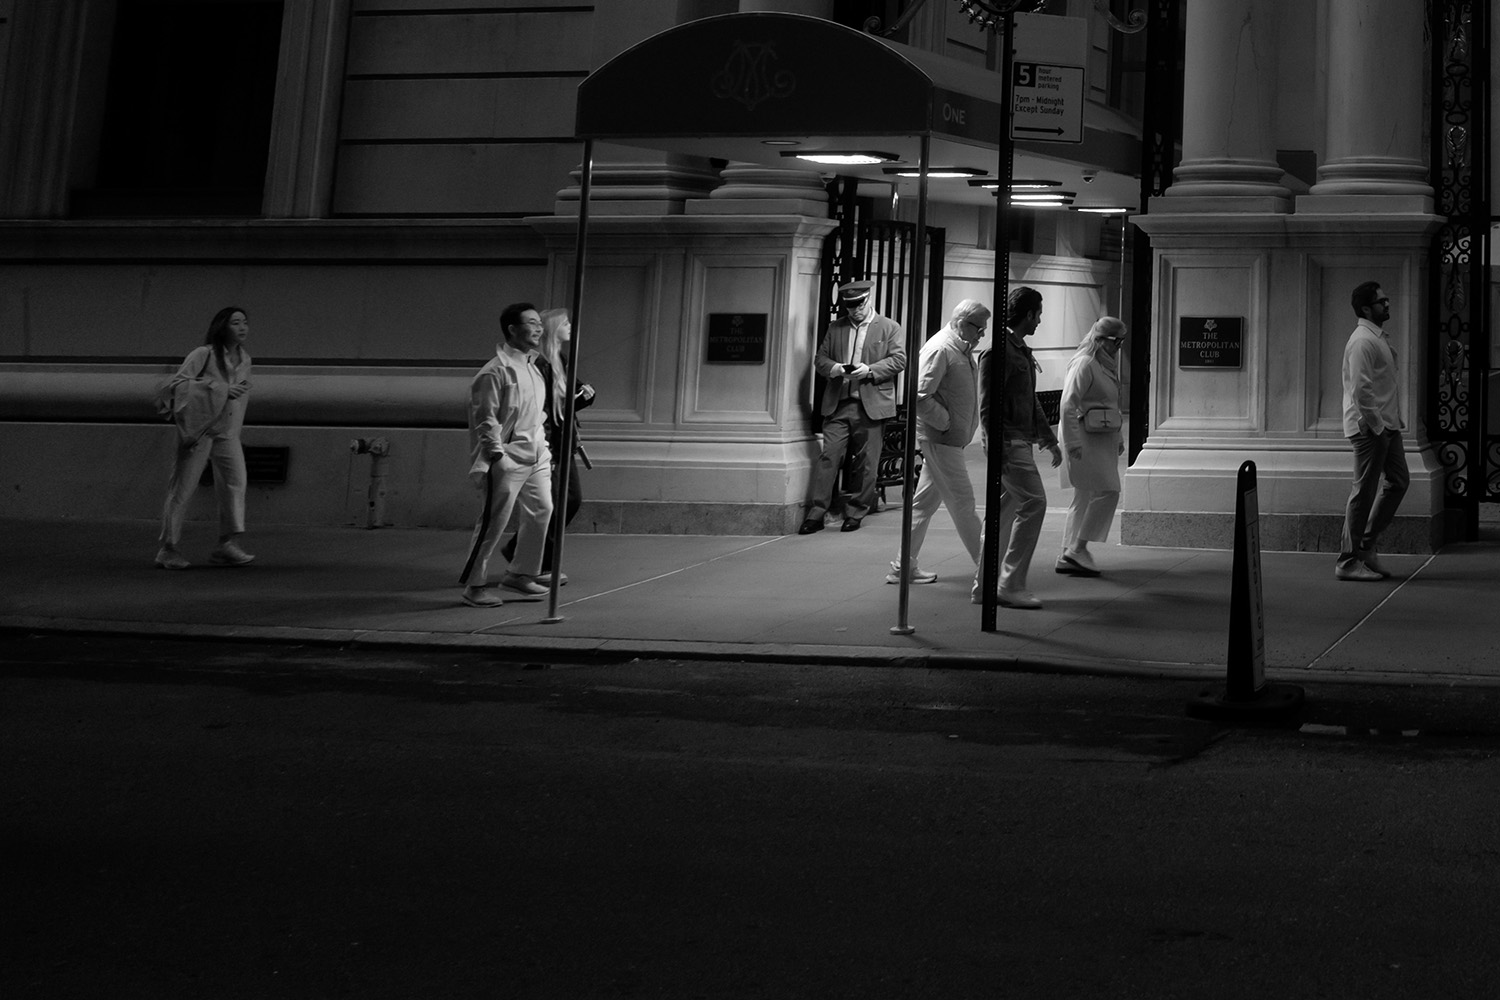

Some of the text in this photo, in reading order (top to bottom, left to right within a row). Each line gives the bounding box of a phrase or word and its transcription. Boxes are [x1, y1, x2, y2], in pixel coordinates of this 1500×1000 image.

[1018, 65, 1030, 85] 5
[1038, 67, 1051, 75] hour
[1038, 82, 1059, 91] parking
[1015, 95, 1030, 103] 7pm
[1036, 96, 1064, 106] Midnight
[1015, 104, 1064, 116] Except Sunday
[1181, 341, 1240, 349] METROPOLITAN
[1199, 350, 1220, 358] CLUB
